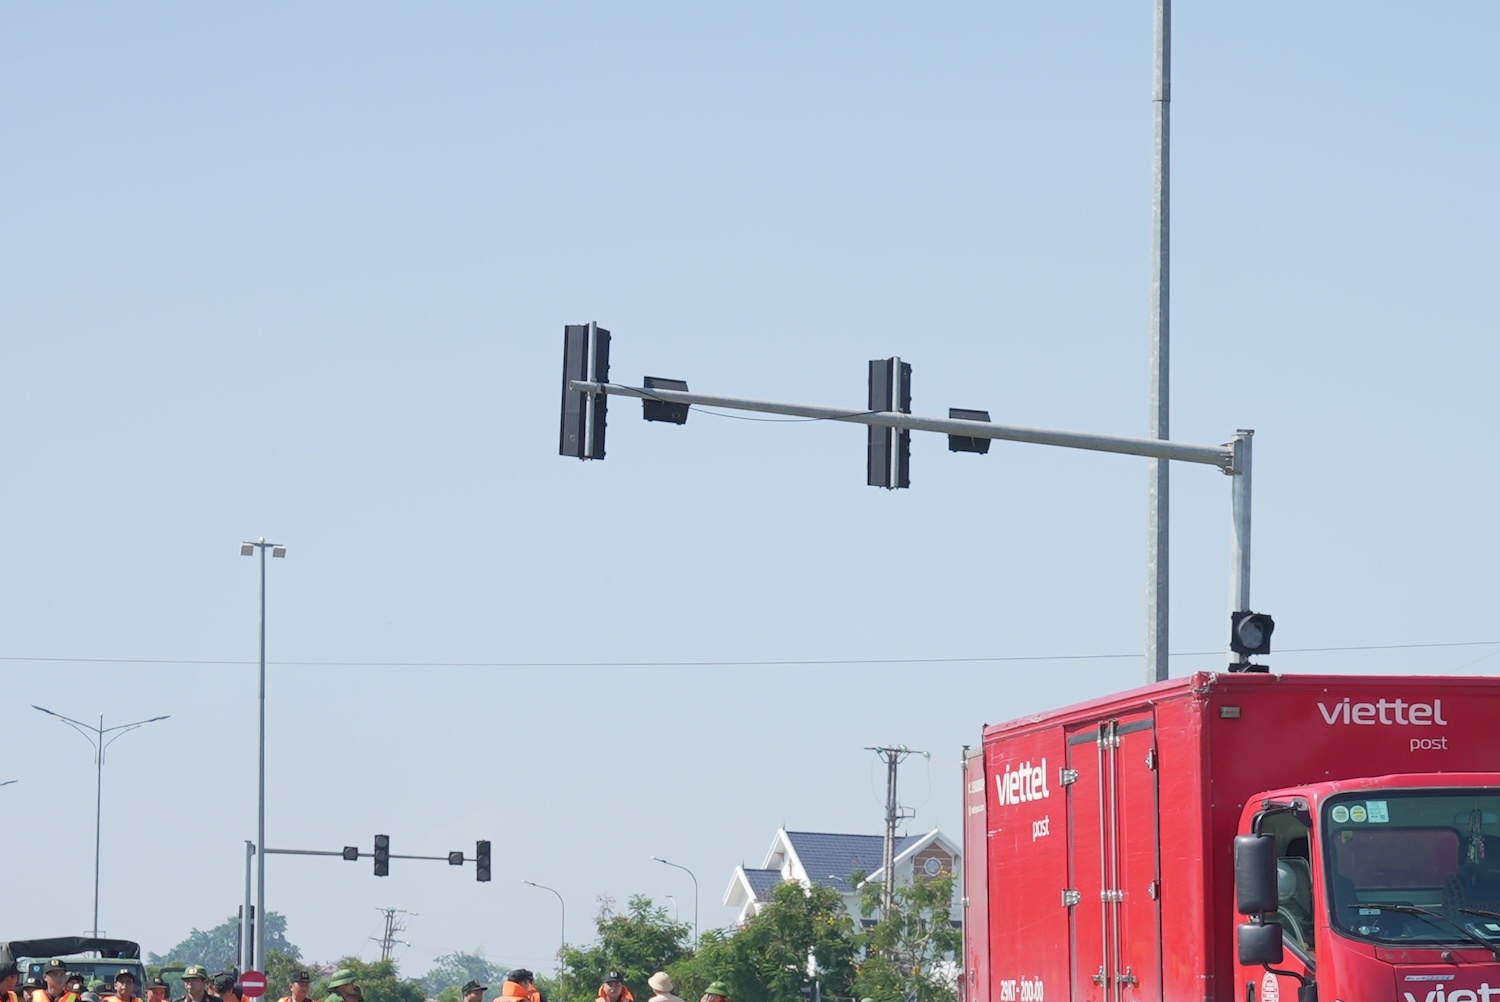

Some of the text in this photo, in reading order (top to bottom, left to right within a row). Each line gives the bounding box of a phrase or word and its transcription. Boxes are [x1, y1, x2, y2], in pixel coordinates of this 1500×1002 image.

[1316, 697, 1448, 726] viettel
[1409, 736, 1448, 753] post
[995, 757, 1050, 807] viettel
[1032, 814, 1050, 842] post
